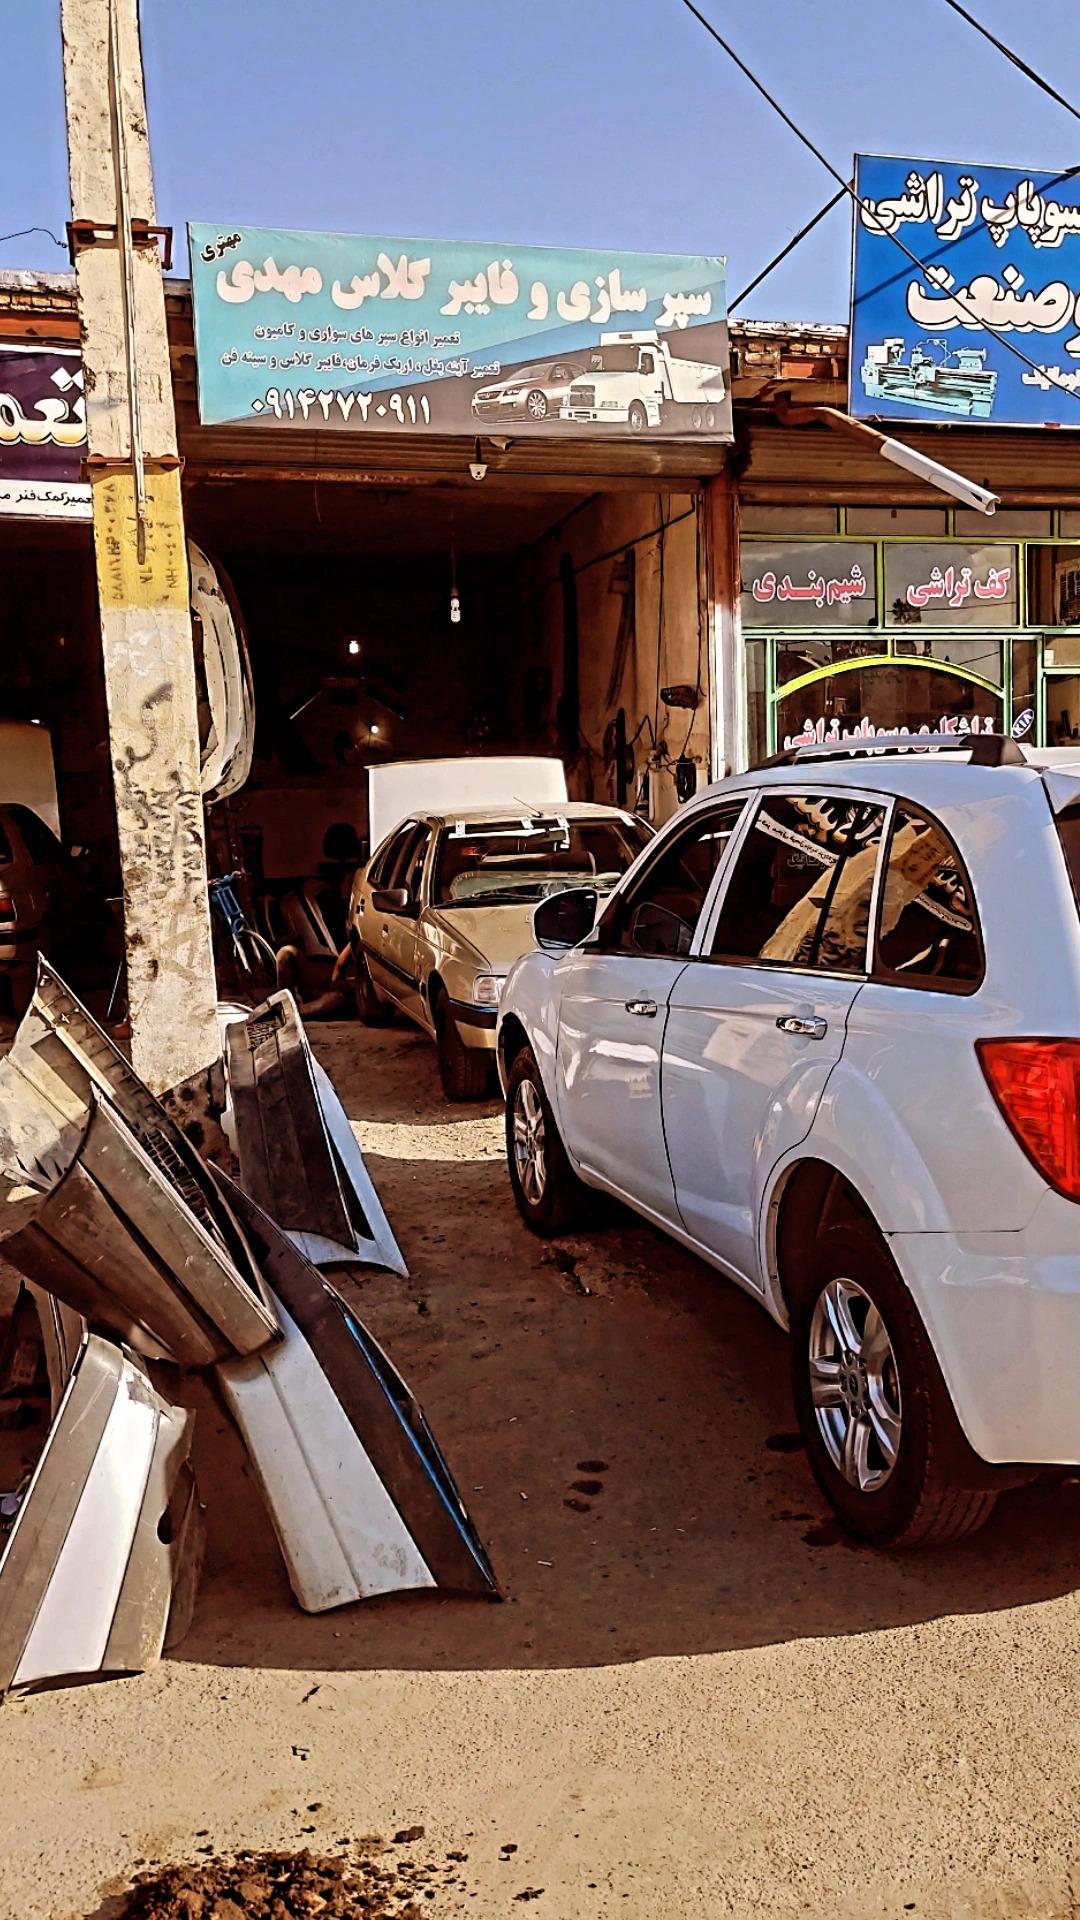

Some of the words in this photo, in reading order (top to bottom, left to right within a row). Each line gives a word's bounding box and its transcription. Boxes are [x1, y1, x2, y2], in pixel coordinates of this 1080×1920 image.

[860, 171, 979, 242] تراشی
[216, 256, 323, 303] مهدی
[440, 259, 518, 316] فایبر
[527, 281, 548, 320] و
[556, 268, 647, 323] سازی
[655, 291, 712, 328] سپر
[254, 322, 296, 340] کامیون
[299, 328, 306, 341] و
[308, 325, 347, 344] سواری
[350, 326, 374, 345] های
[399, 328, 430, 347] انواع
[431, 330, 461, 348] تعمیر
[221, 347, 239, 367] فن
[241, 350, 267, 367] سینه
[269, 356, 277, 369] و
[470, 361, 501, 378] تعمیر
[251, 387, 431, 425] ۰۹۱۴۲۷۲۰۹۱۱
[752, 570, 826, 609] بندی
[906, 565, 972, 607] تراشی
[974, 567, 1011, 598] کف
[1013, 712, 1034, 736] KIA
